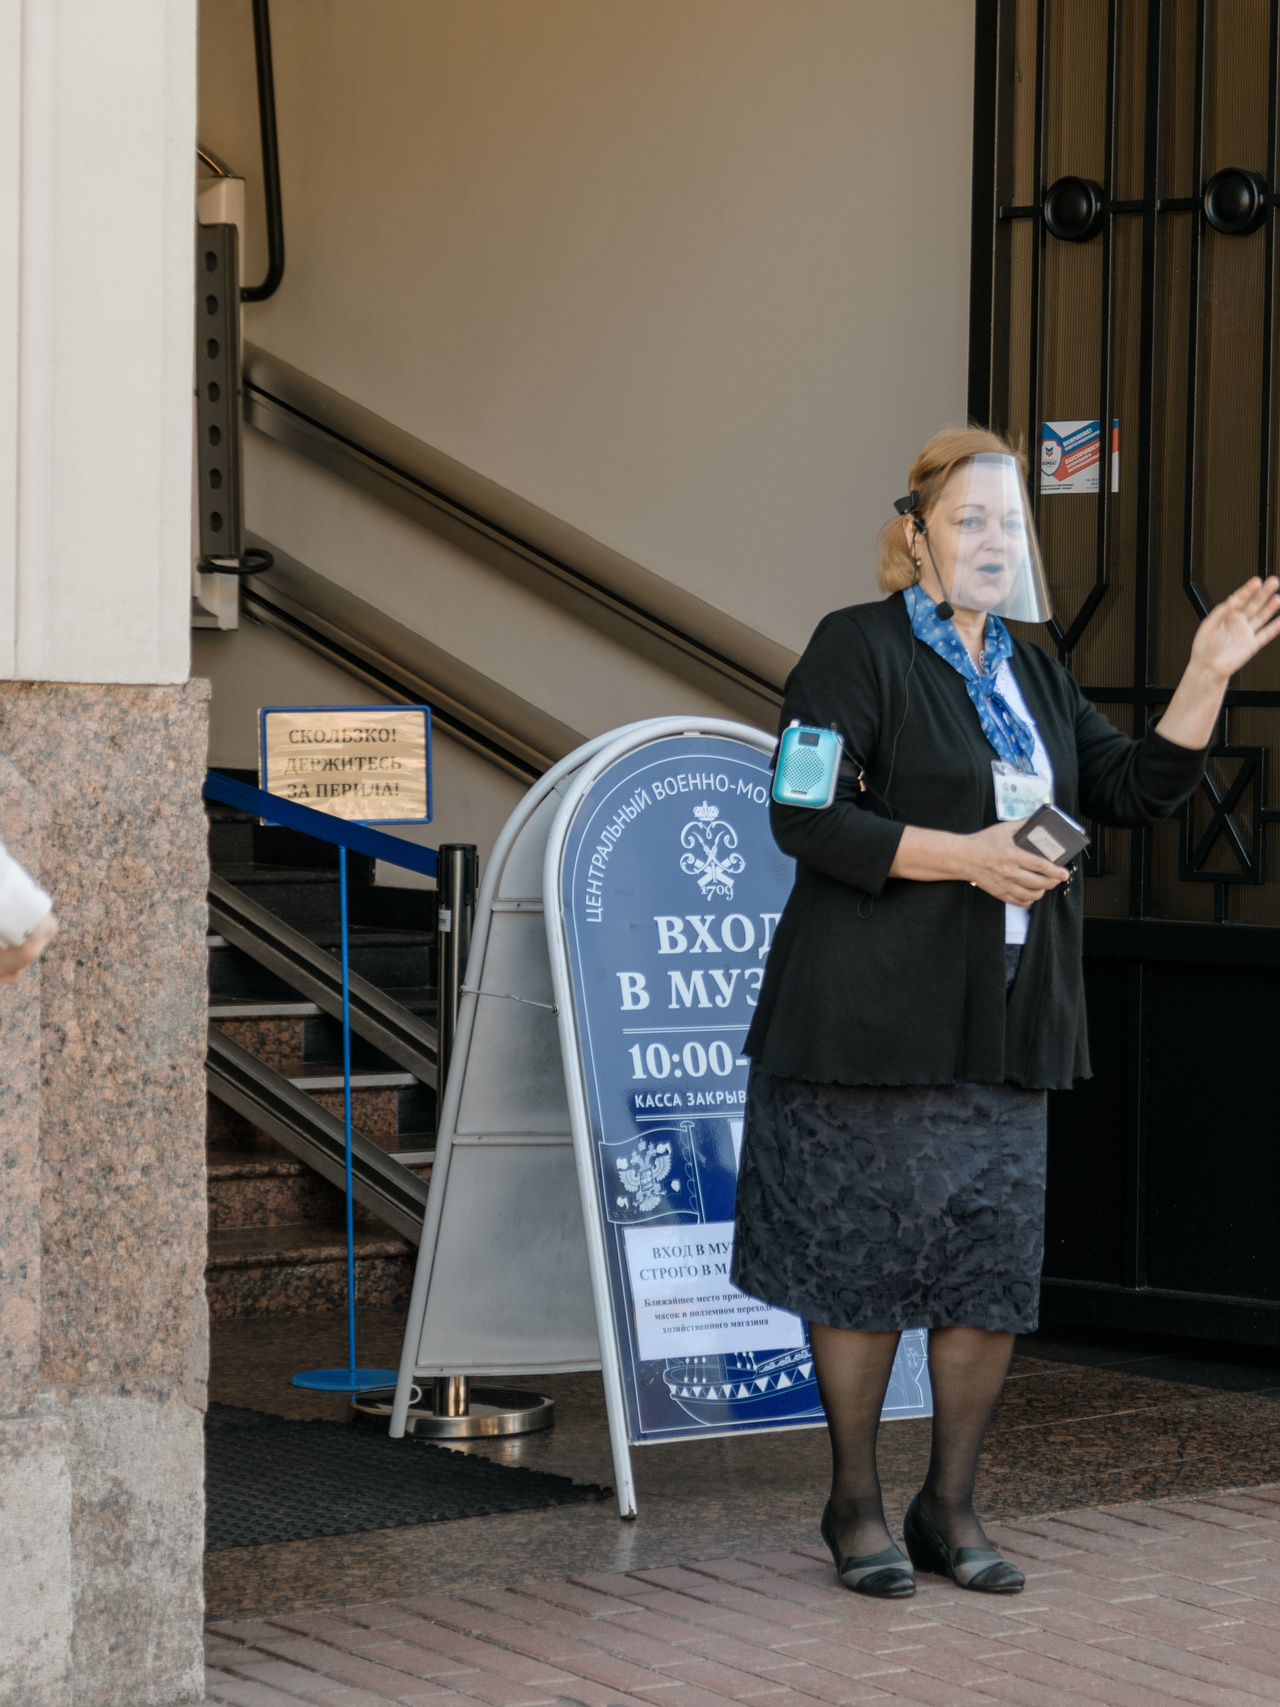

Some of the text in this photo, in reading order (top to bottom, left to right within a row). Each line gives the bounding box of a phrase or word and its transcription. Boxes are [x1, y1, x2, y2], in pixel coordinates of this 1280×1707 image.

[289, 728, 397, 744] СКОЛЬЗКО!
[284, 756, 402, 775] ДЕРЖИТЕСЬ
[287, 782, 399, 798] ЗА ПЕРИЛА!
[586, 788, 653, 923] ЦЕНТРАЛЬНЫЙ
[701, 884, 734, 901] 1709
[653, 913, 783, 959] ВХОД
[616, 968, 766, 1011] В МУЗ
[627, 1040, 748, 1079] 10:00-
[634, 1090, 747, 1108] КАССА ЗАКРЫВ
[652, 1242, 735, 1260] ВХОД В МУ
[639, 1265, 698, 1281] СТРОГО
[702, 1264, 711, 1276] В
[644, 1296, 694, 1307] Ближайшее
[696, 1294, 720, 1304] место
[654, 1312, 680, 1321] масок
[689, 1307, 735, 1318] подземном
[662, 1318, 769, 1334] хозяйственного магазина
